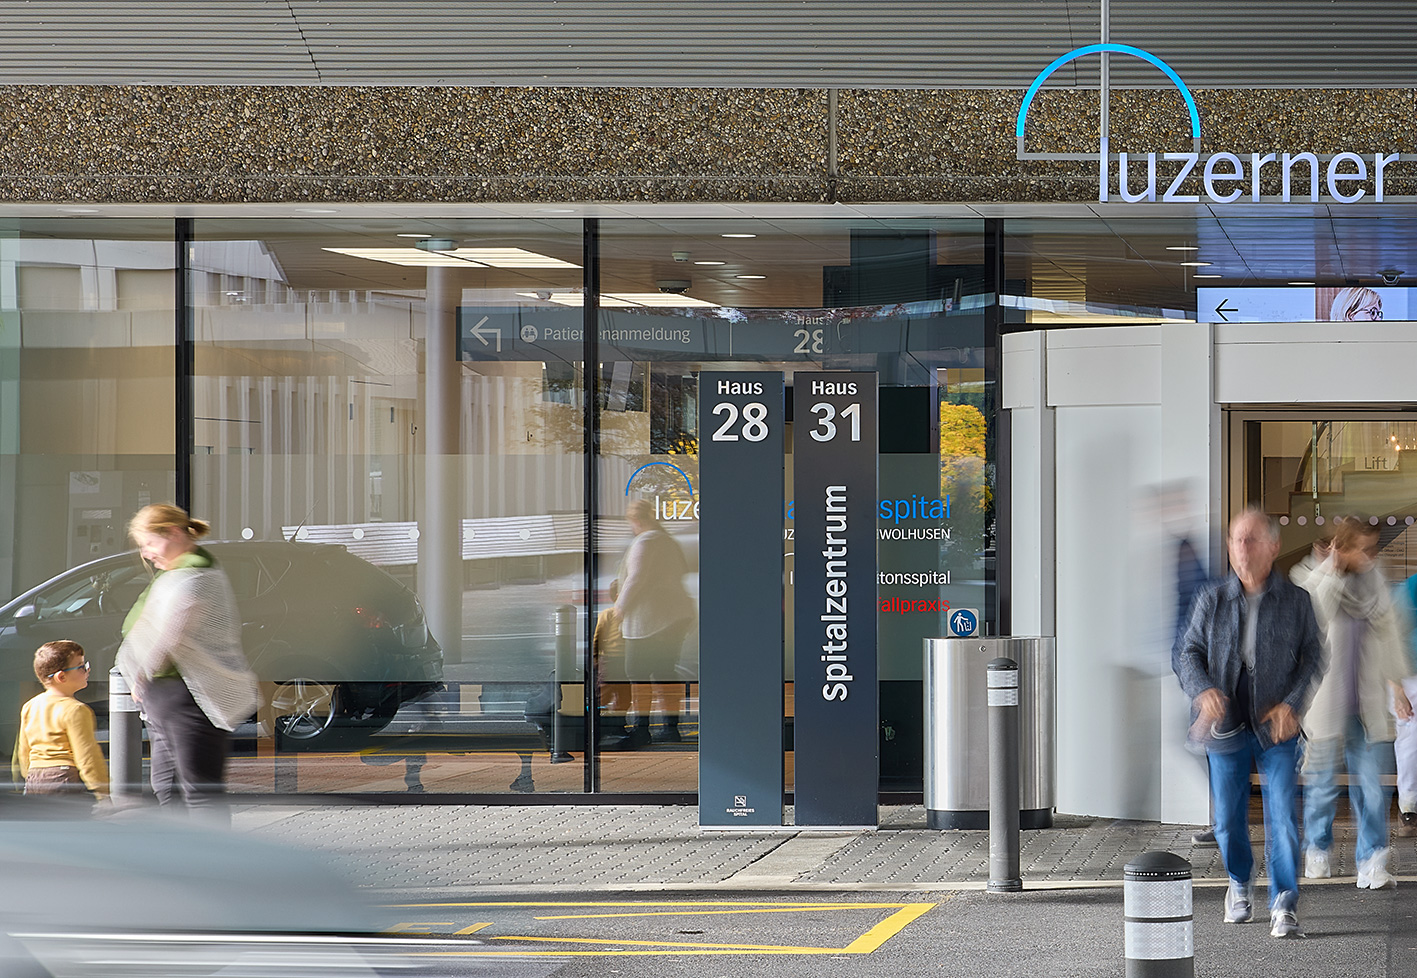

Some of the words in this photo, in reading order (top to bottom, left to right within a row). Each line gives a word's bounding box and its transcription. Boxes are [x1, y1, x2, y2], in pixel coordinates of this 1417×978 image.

[1100, 137, 1399, 203] luzerner
[717, 380, 763, 395] Haus
[811, 380, 857, 395] Haus
[712, 402, 769, 442] 28
[809, 402, 861, 442] 31
[1364, 456, 1389, 470] Lift
[879, 528, 951, 540] WOLHUSEN
[877, 570, 951, 587] tonsspital
[821, 485, 853, 701] Spitalzentrum
